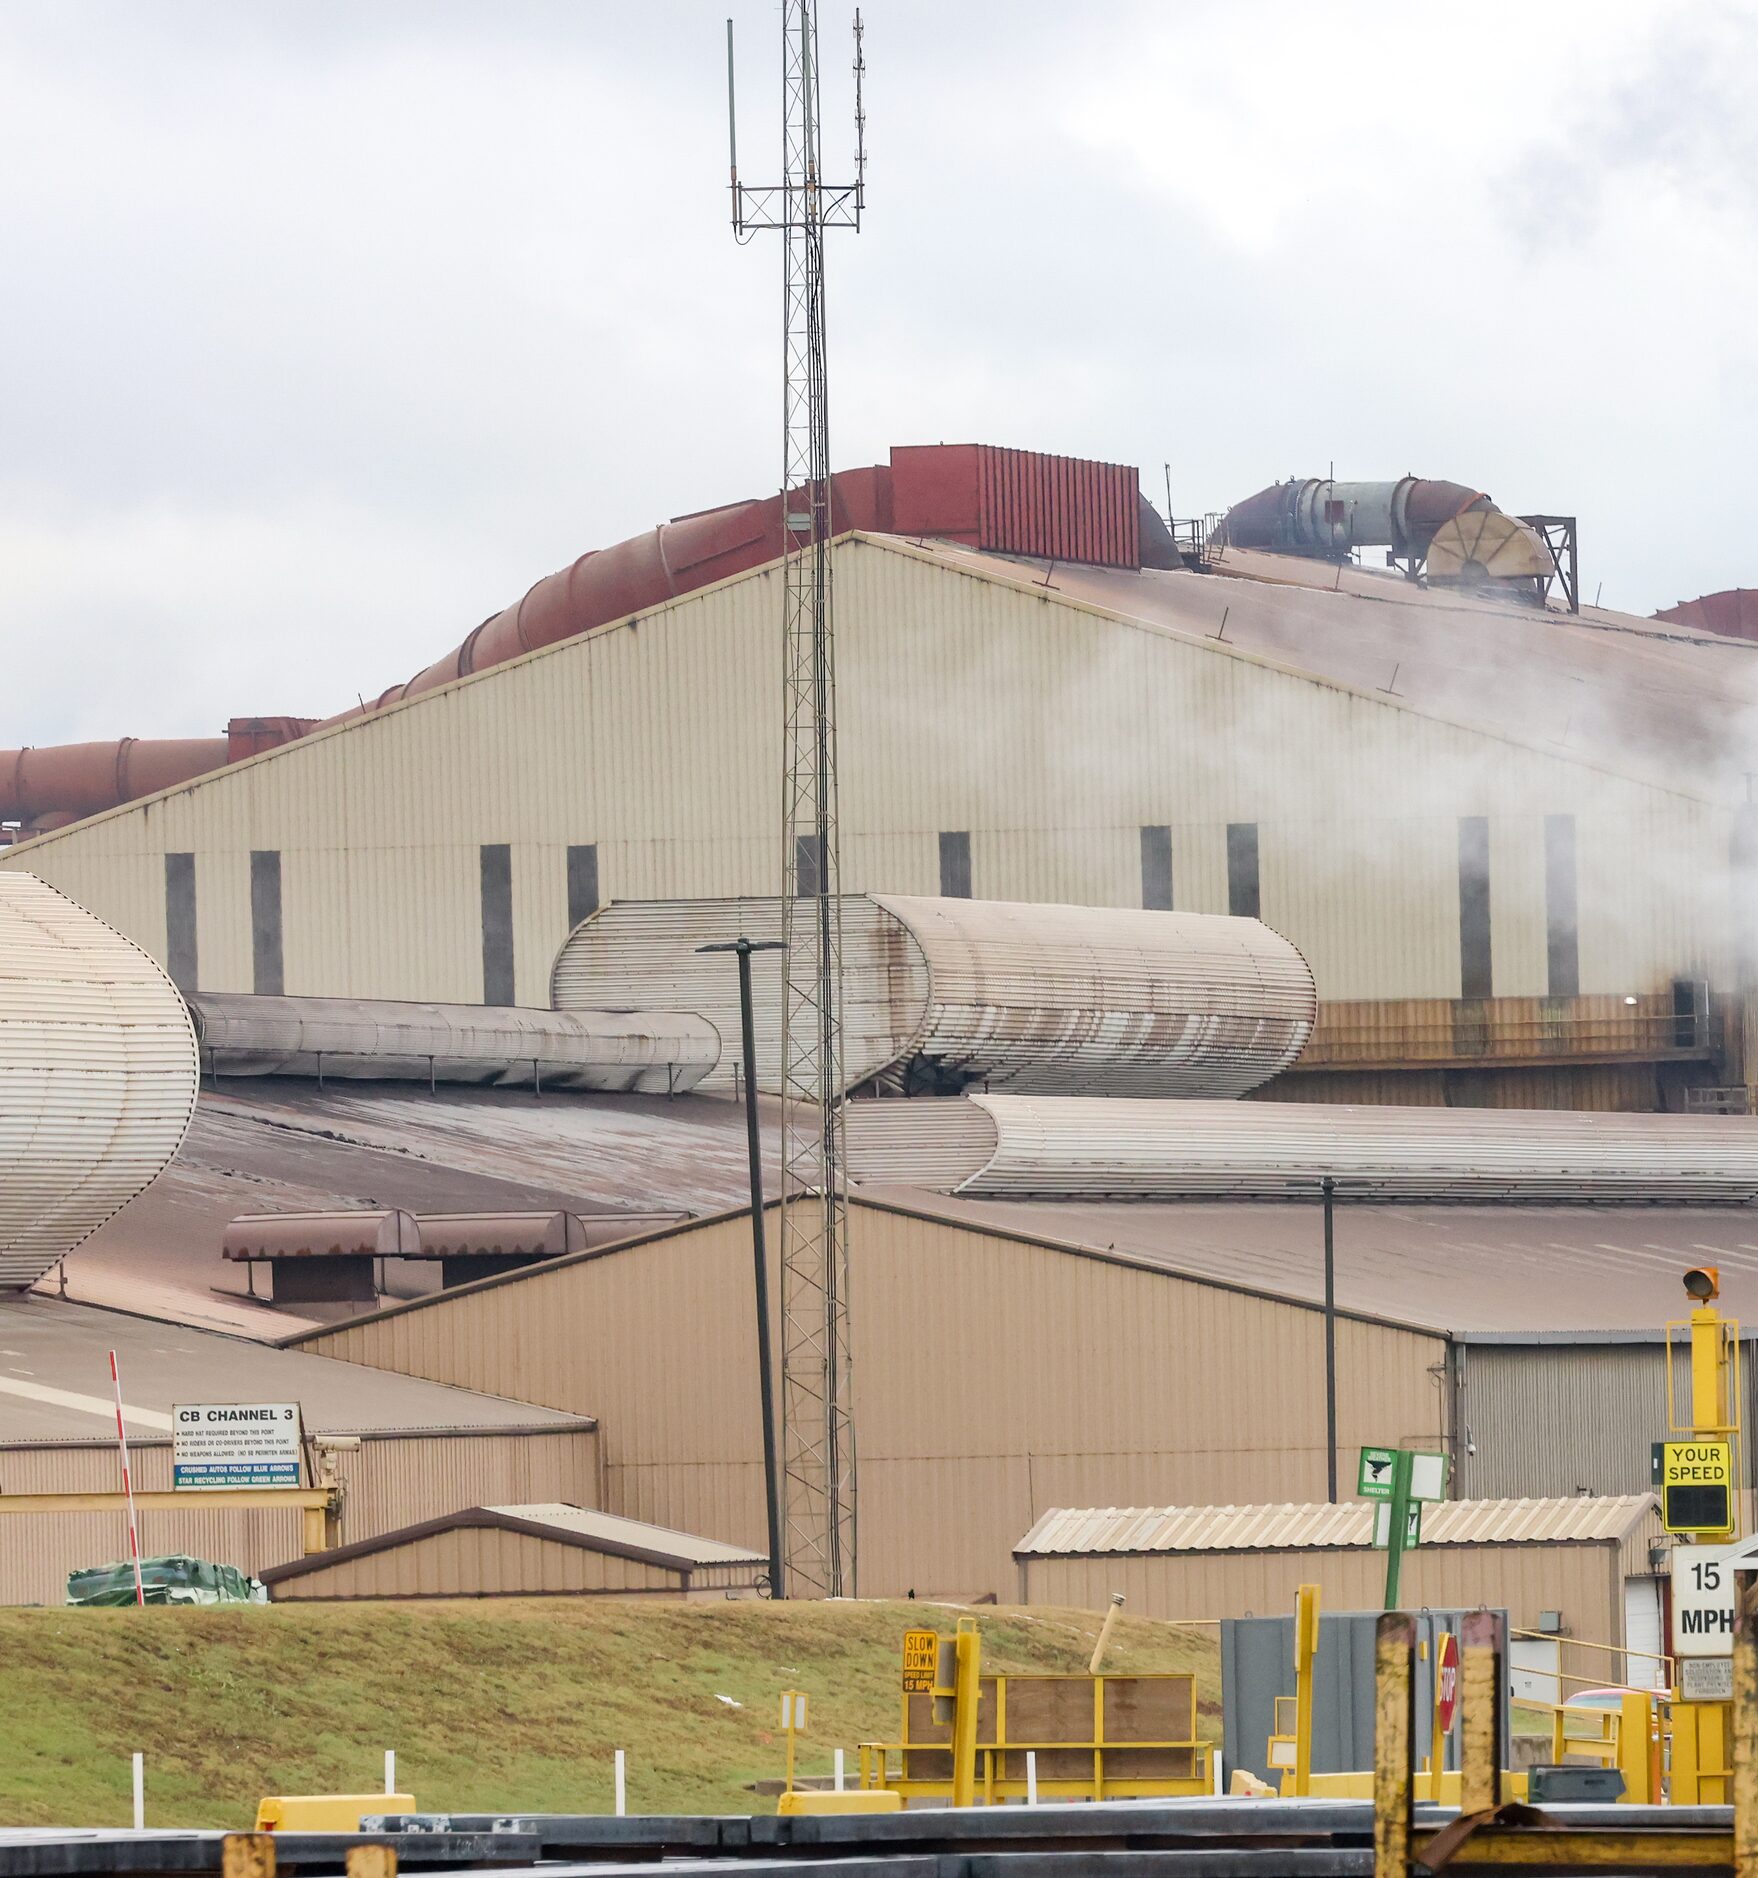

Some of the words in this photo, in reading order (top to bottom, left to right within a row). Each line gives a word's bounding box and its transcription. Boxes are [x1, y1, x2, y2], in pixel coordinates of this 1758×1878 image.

[180, 1411, 200, 1422] CB
[207, 1409, 278, 1421] CHANNEL
[284, 1409, 293, 1420] 3
[1672, 1448, 1721, 1461] YOUR
[180, 1466, 208, 1474] CRUSHED
[209, 1465, 228, 1473] AUTOS
[229, 1465, 252, 1473] FOLLOW
[269, 1464, 294, 1472] ARROWS
[1669, 1467, 1724, 1480] SPEED
[1363, 1486, 1390, 1495] SHELTER
[1691, 1563, 1720, 1591] 15
[1682, 1609, 1734, 1634] MPH
[908, 1636, 933, 1651] SLOW
[906, 1653, 933, 1667] DOWN
[904, 1680, 915, 1690] 15
[916, 1680, 934, 1690] MPH
[1440, 1667, 1456, 1702] STOP
